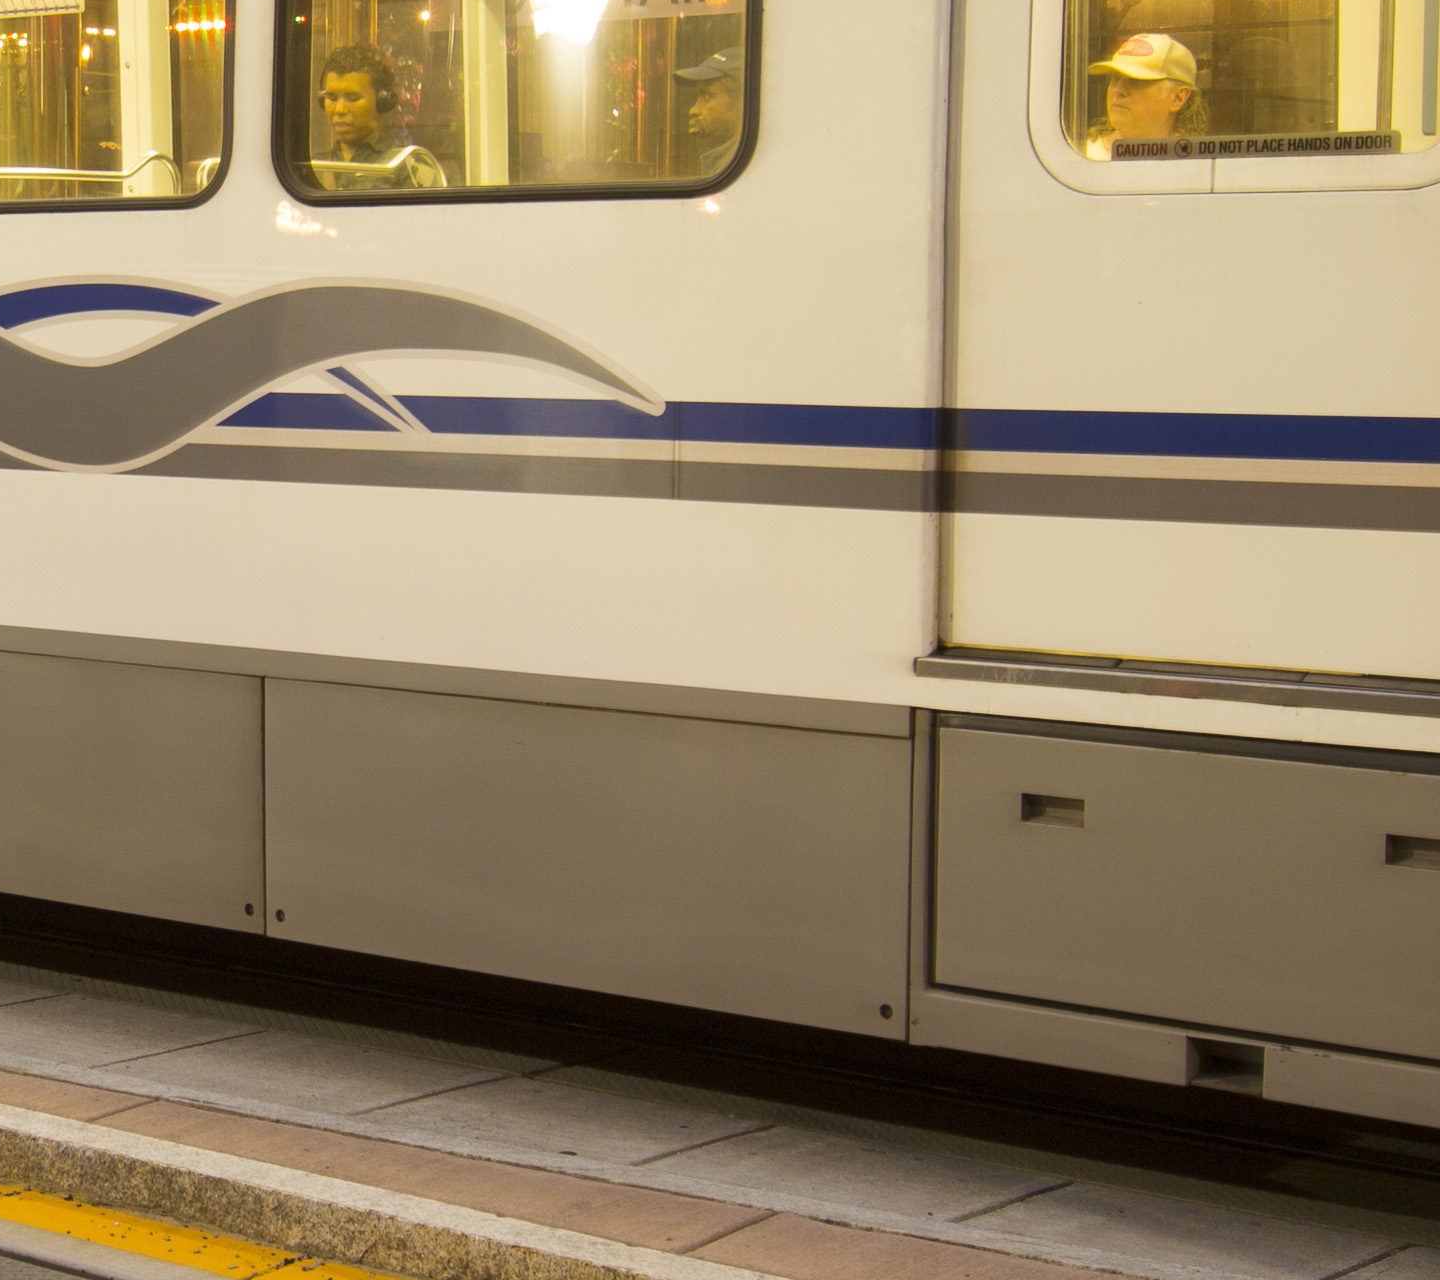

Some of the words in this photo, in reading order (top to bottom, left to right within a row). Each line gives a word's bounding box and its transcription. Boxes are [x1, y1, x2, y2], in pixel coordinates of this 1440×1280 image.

[1116, 142, 1168, 157] CAUTION
[1198, 141, 1216, 154] DO
[1219, 140, 1245, 153] NOT
[1246, 138, 1284, 153] PLACE
[1287, 137, 1330, 152] HANDS
[1334, 136, 1353, 150] ON
[1355, 134, 1392, 150] DOOR
